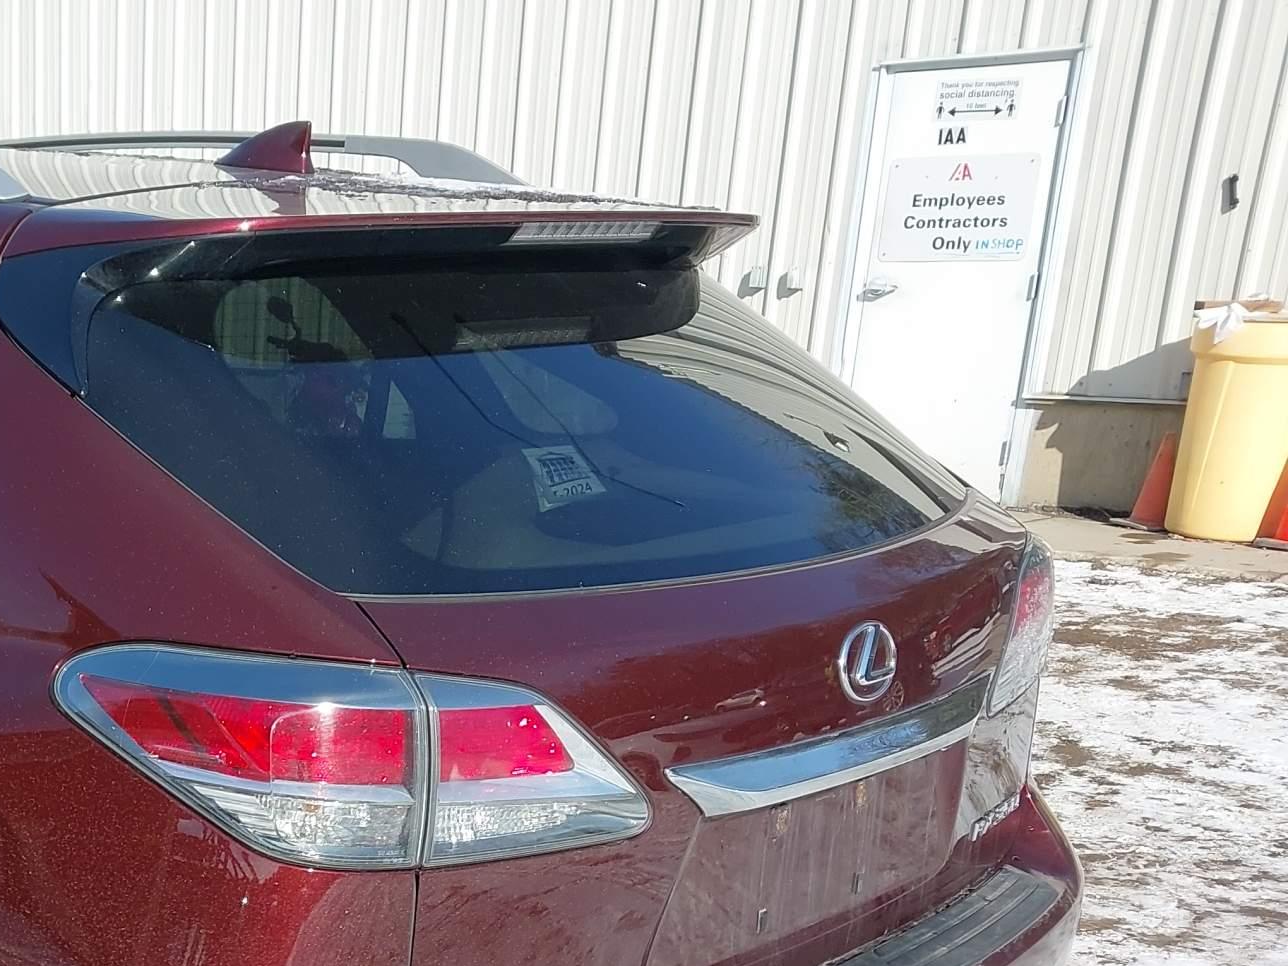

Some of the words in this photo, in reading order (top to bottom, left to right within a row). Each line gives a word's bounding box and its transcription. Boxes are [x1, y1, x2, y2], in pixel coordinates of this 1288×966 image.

[939, 90, 966, 100] social
[967, 89, 1015, 99] distancing
[938, 127, 967, 145] IAA
[912, 193, 1006, 210] Employees
[903, 215, 1008, 229] Contractors
[932, 236, 971, 253] Only
